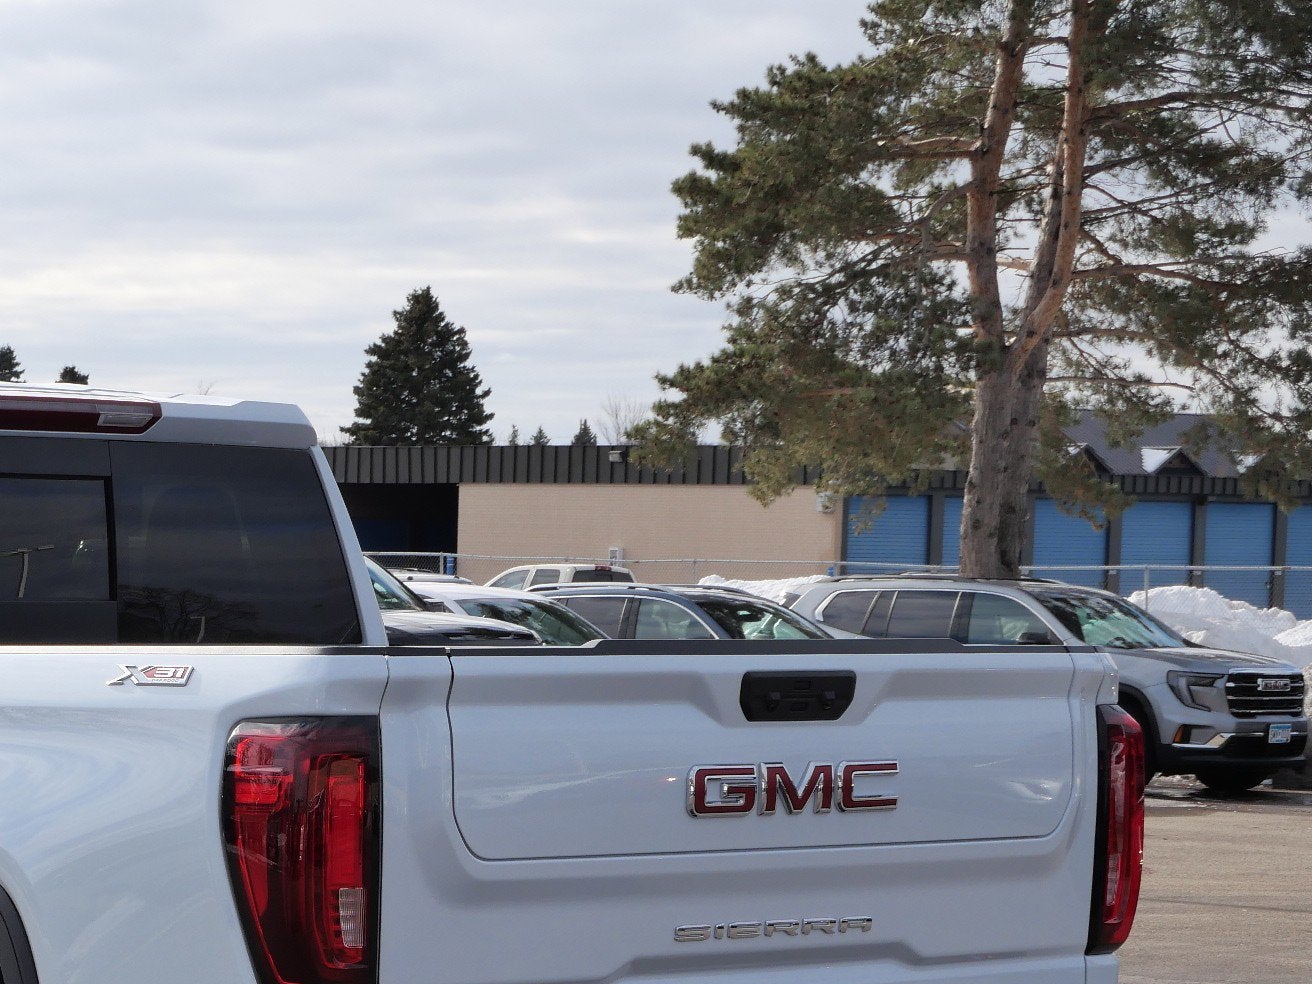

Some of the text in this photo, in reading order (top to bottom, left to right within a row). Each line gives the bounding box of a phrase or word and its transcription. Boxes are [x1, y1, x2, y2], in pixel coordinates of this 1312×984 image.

[105, 664, 194, 687] X31
[687, 759, 899, 817] GMC
[674, 915, 873, 942] SIERRA
